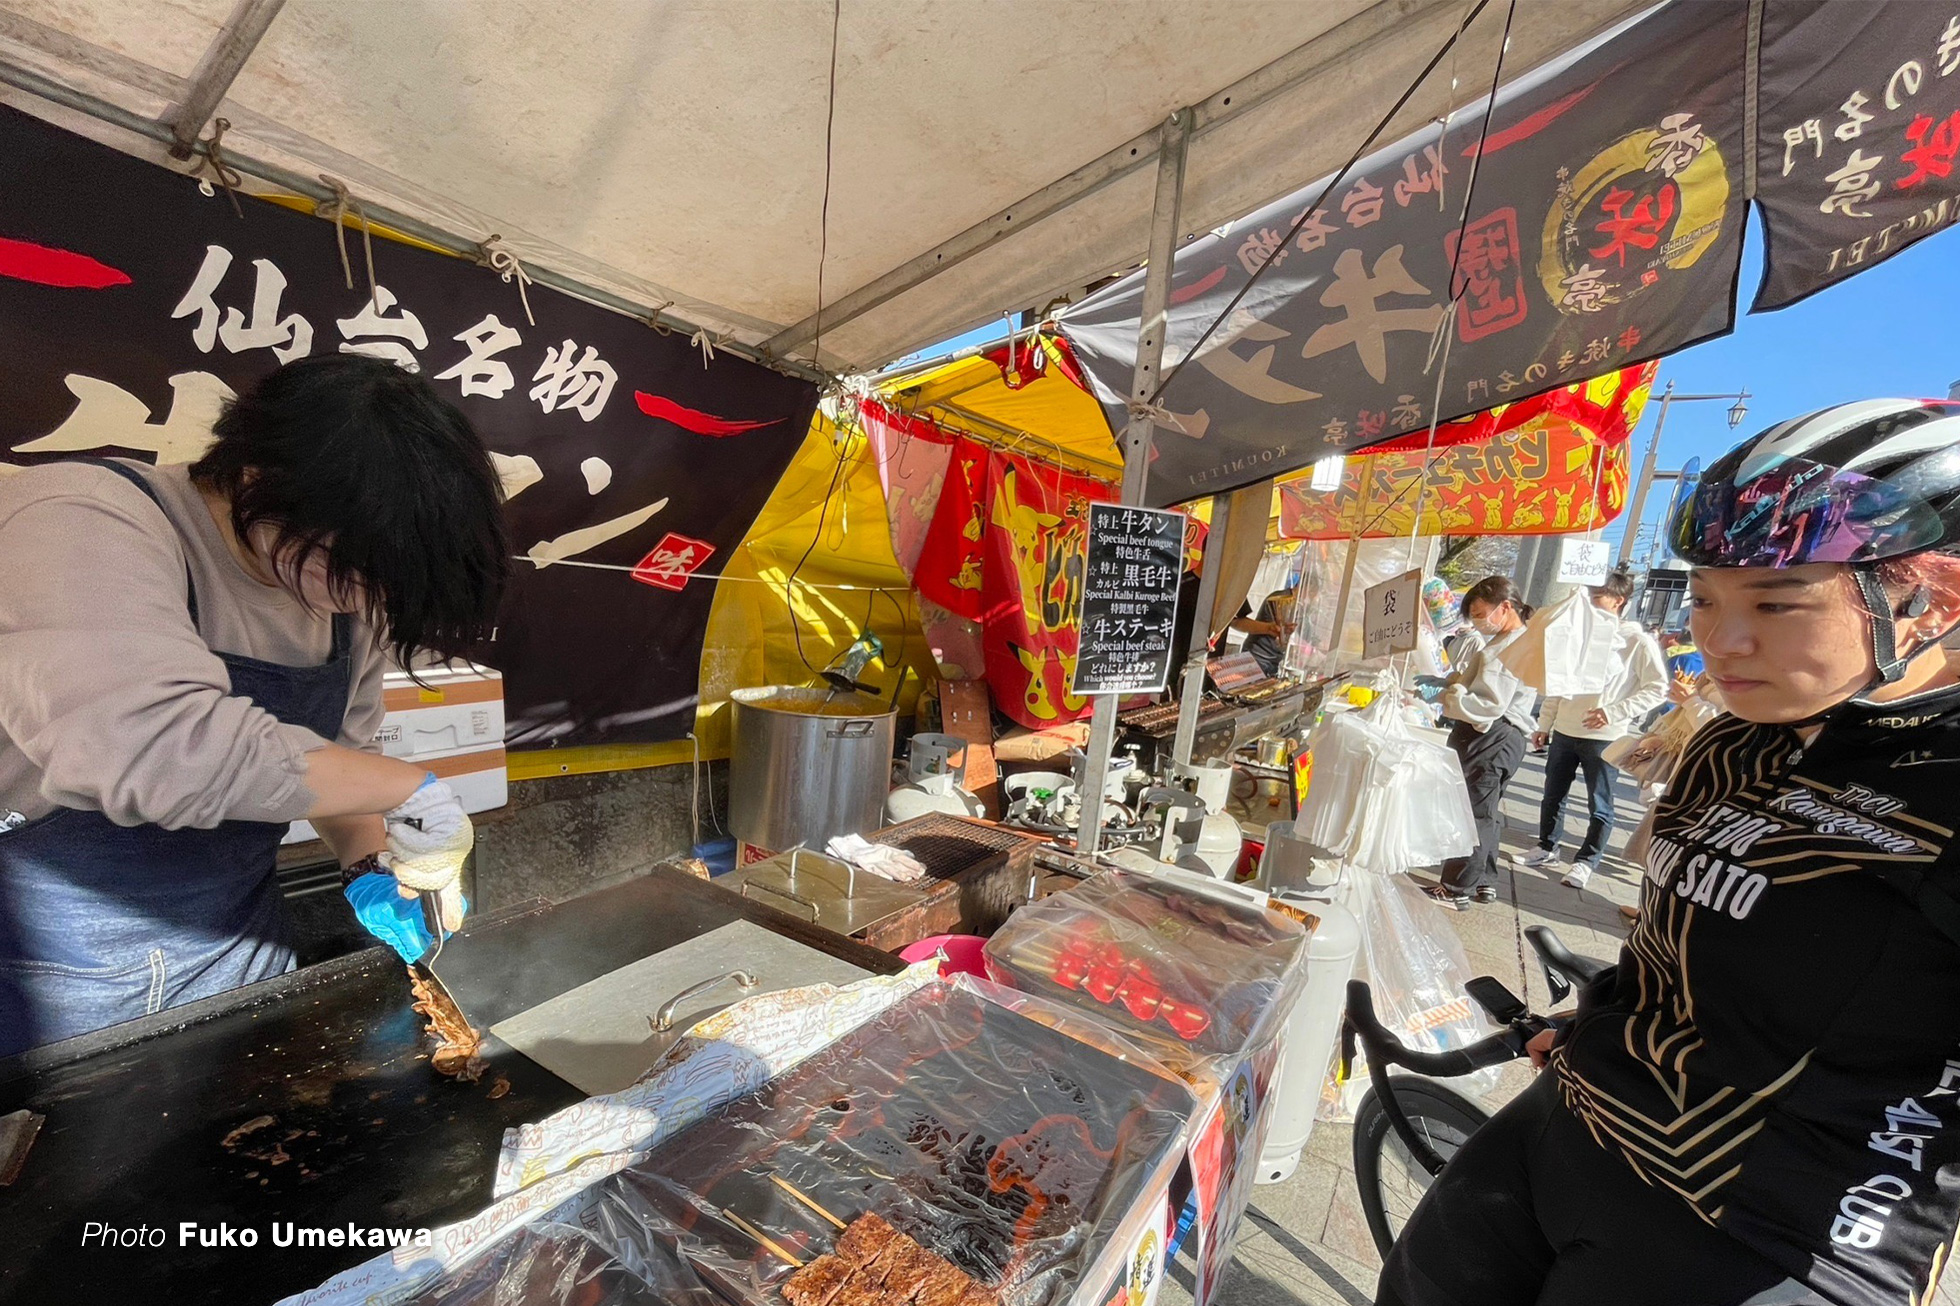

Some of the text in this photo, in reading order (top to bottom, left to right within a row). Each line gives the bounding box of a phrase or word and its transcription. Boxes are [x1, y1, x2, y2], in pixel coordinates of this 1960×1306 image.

[1098, 513, 1119, 529] 特上
[1121, 510, 1169, 534] 牛タン
[1098, 532, 1173, 550] Special beef tongue
[1100, 561, 1118, 575] 特上
[1096, 578, 1120, 589] カルビ
[1085, 589, 1113, 601] Special
[1114, 590, 1133, 600] Kalbi
[1135, 591, 1160, 603] Kuroge
[1094, 618, 1173, 642] 牛ステーキ
[1092, 640, 1166, 654] Special beef steak
[1676, 853, 1767, 920] SATO
